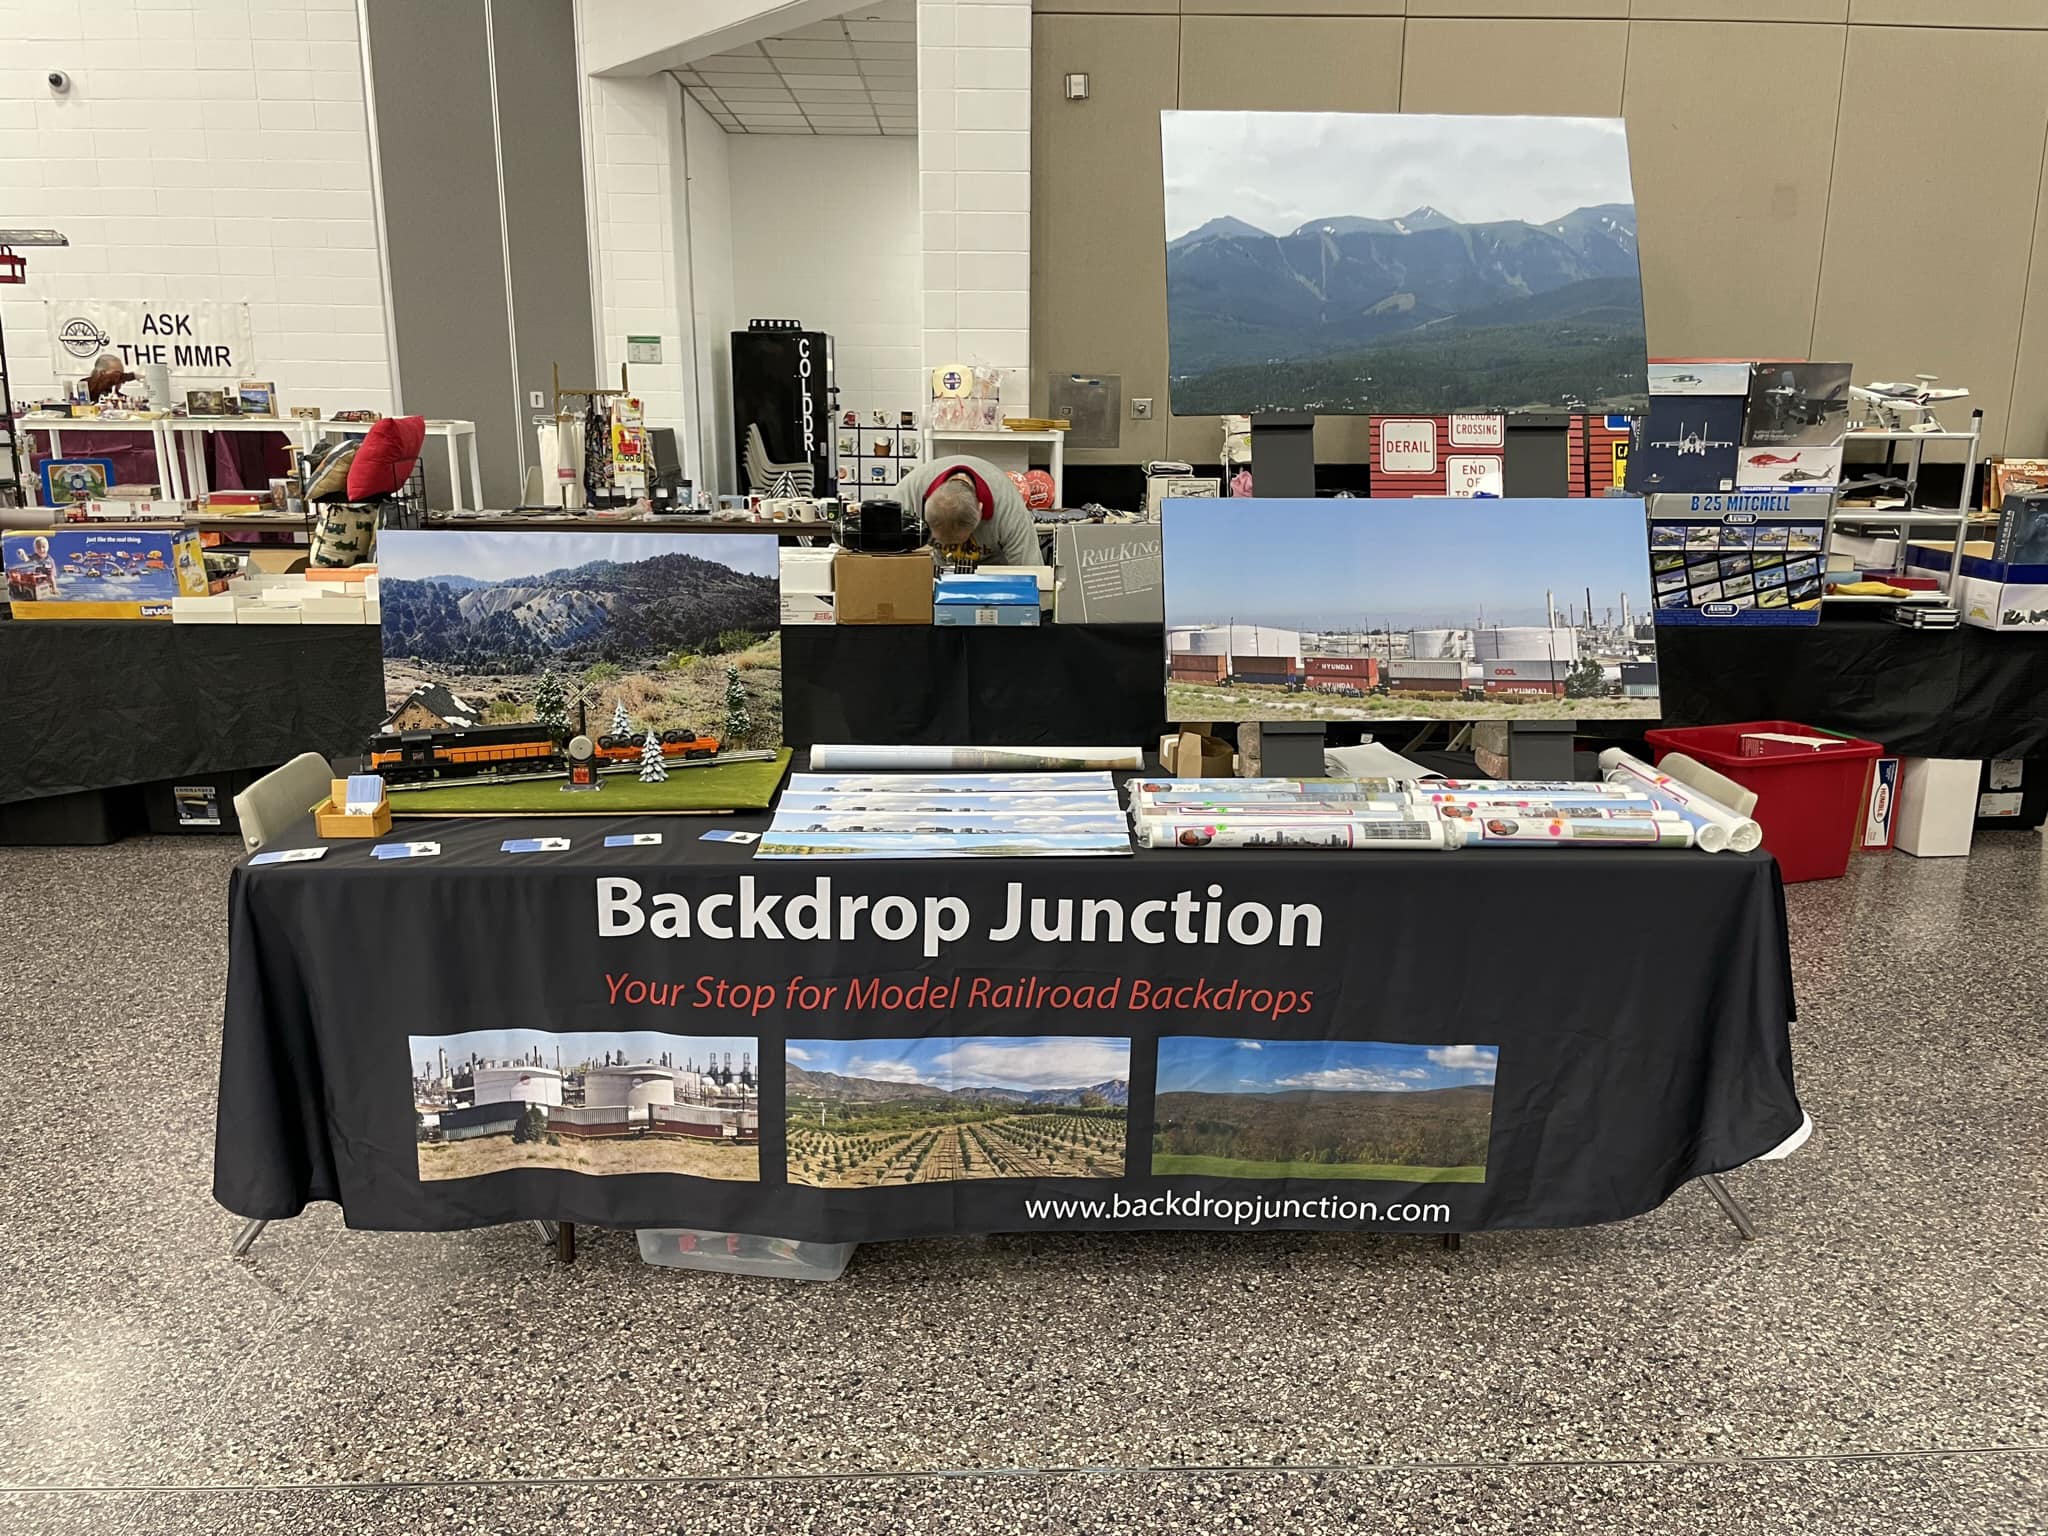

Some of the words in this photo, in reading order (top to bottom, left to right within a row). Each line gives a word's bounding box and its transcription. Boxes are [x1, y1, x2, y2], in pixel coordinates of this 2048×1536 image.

[142, 313, 192, 336] ASK
[117, 344, 168, 366] THE
[174, 345, 232, 367] MMR
[1456, 424, 1497, 435] CROSSING
[1386, 440, 1431, 453] DERAIL
[1462, 464, 1486, 475] END
[1466, 477, 1481, 488] OF
[1691, 495, 1700, 512] B
[1703, 495, 1722, 512] 25
[1726, 495, 1791, 512] MITCHELL
[141, 604, 172, 616] brude
[1321, 663, 1353, 671] HYUNDAI
[596, 875, 970, 957] Backdrop
[988, 882, 1324, 947] Junction
[606, 974, 685, 1008] Your
[694, 975, 776, 1017] Stop
[786, 976, 837, 1012] for
[845, 977, 961, 1011] Model
[969, 976, 1121, 1014] Railroad
[1129, 979, 1313, 1020] Backdrops
[1025, 1189, 1451, 1226] www.backdropjunction.com
